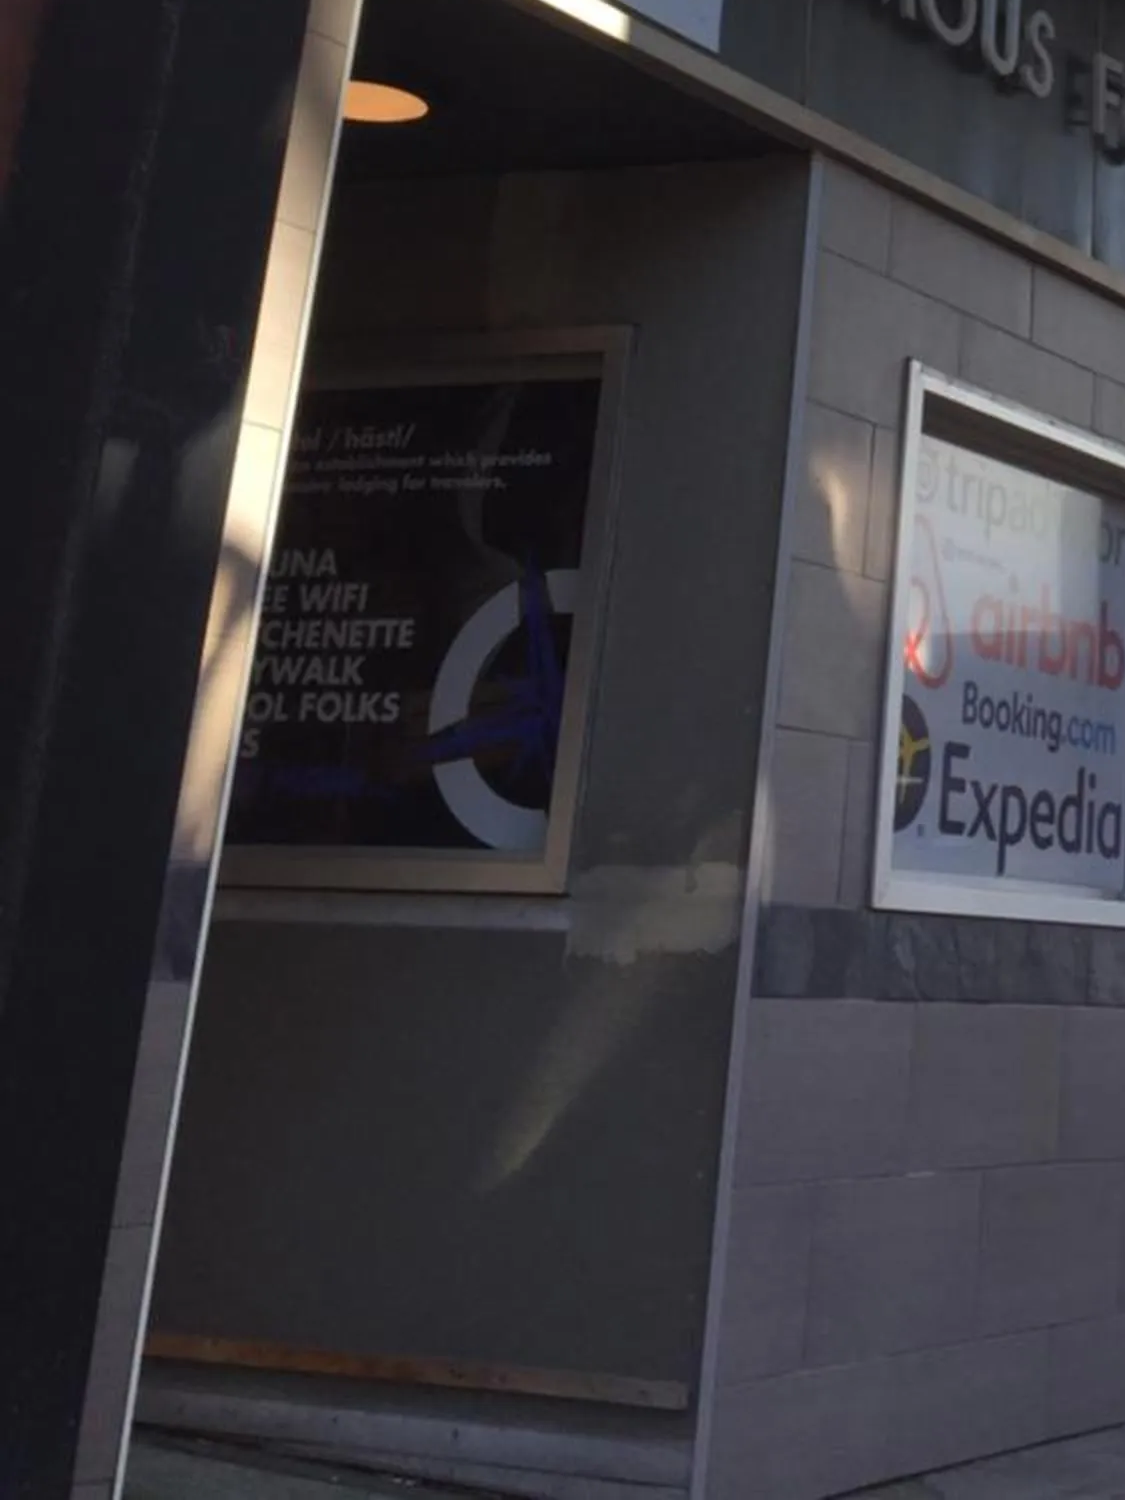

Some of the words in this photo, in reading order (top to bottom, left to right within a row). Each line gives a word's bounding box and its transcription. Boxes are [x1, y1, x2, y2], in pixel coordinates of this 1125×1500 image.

[268, 547, 338, 578] UNA
[262, 583, 290, 613] EE
[298, 582, 370, 613] WIFI
[261, 616, 416, 649] CHENETTE
[252, 654, 367, 687] YWALK
[247, 690, 290, 723] OL
[297, 690, 402, 724] FOLKS
[961, 679, 1118, 756] Booking.com
[936, 740, 1123, 878] Expedia
